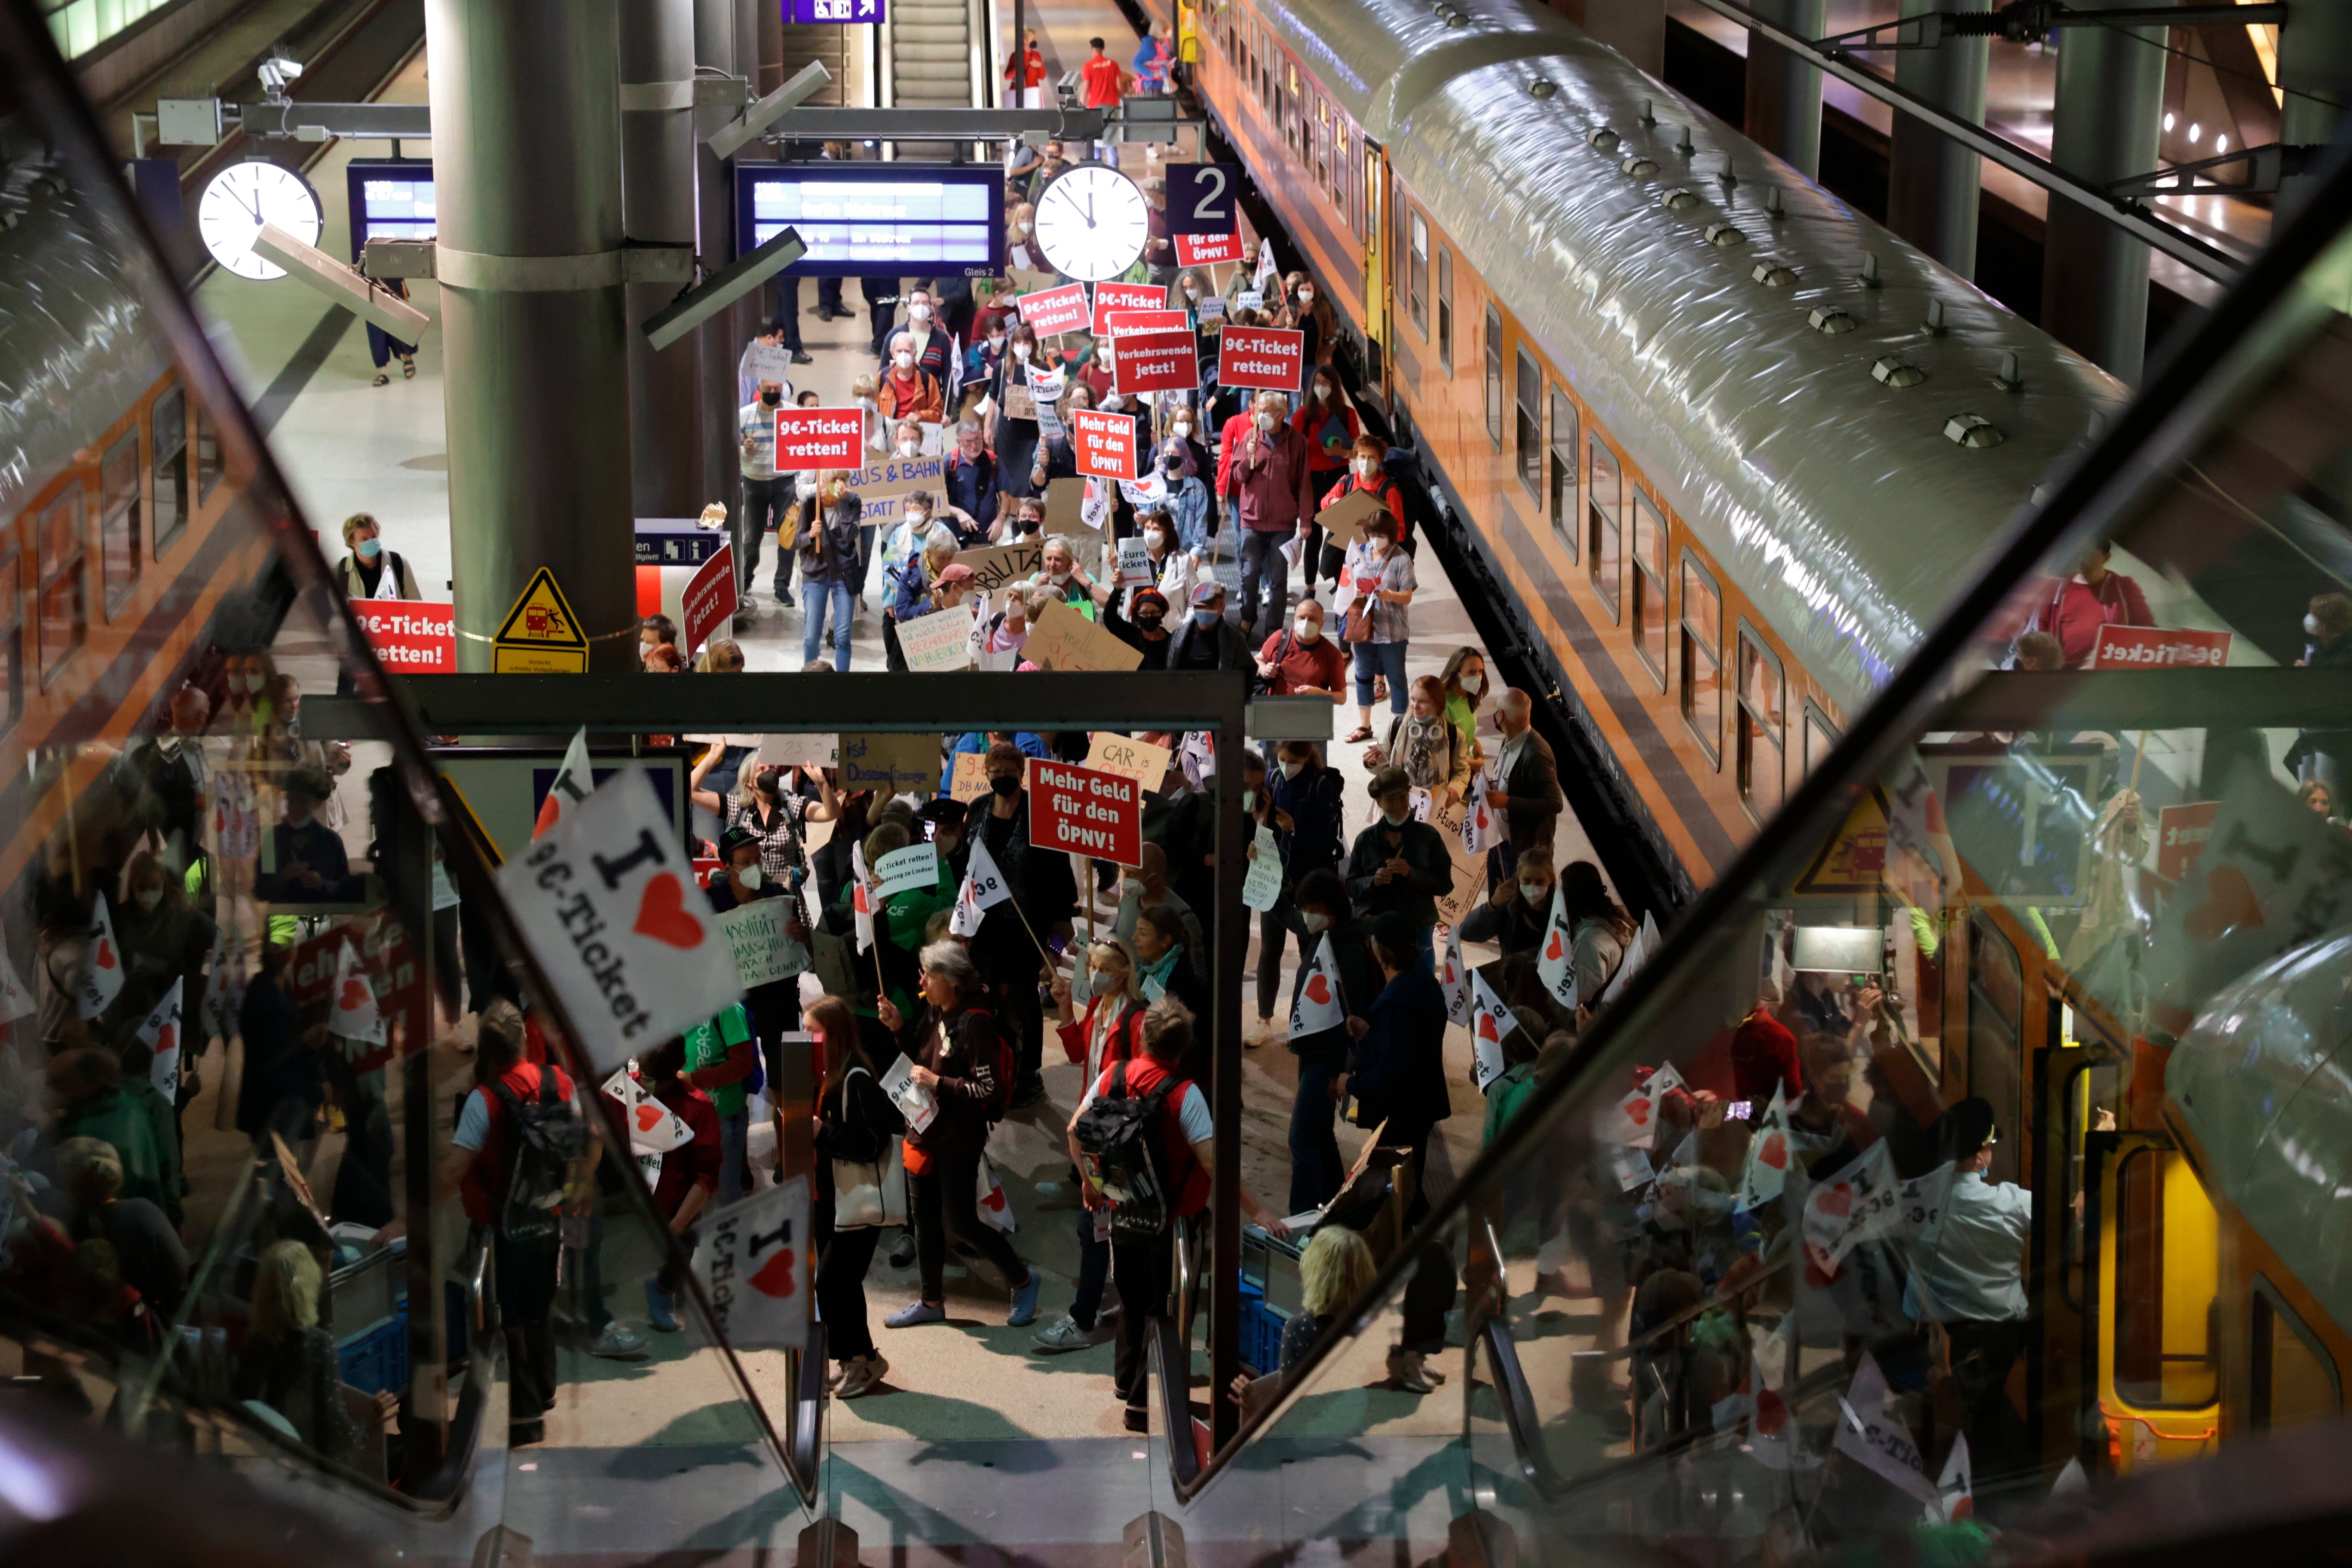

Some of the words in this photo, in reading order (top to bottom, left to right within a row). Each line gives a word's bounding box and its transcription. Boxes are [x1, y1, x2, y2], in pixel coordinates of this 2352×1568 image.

[1194, 167, 1225, 218] 2
[802, 202, 839, 217] Berlin
[843, 202, 907, 218] Südkreuz
[1188, 234, 1205, 245] für
[1208, 234, 1228, 243] den
[1193, 246, 1228, 260] ÖPNV!
[965, 268, 986, 276] Gleis
[987, 268, 994, 276] 2
[1023, 293, 1083, 315] 9€-Ticket
[1098, 292, 1162, 309] 9€-Ticket
[1034, 309, 1078, 328] retten!
[1118, 345, 1192, 360] Verkehrswende
[1225, 337, 1298, 356] 9€-Ticket
[1135, 361, 1176, 379] jetzt!
[1233, 361, 1287, 376] retten!
[780, 419, 859, 436] 9€-Ticket
[1080, 416, 1105, 431] Mehr
[1107, 419, 1130, 435] Geld
[789, 441, 847, 456] retten!
[1087, 434, 1104, 449] für
[1106, 437, 1124, 452] den
[1091, 451, 1122, 472] ÖPNV!
[850, 466, 882, 486] BUS
[887, 465, 898, 482] &
[902, 459, 940, 480] BAHN
[860, 500, 896, 520] STATT
[684, 565, 730, 620] Verkehrswende
[692, 591, 719, 634] jetzt!
[375, 645, 442, 665] etten!
[846, 738, 867, 758] ist
[1103, 745, 1134, 768] CAR
[1141, 757, 1149, 768] is
[958, 781, 971, 791] DB
[1040, 767, 1086, 792] Mehr
[1090, 778, 1130, 802] Geld
[1053, 794, 1081, 815] für
[1086, 801, 1119, 824] den
[1057, 818, 1115, 851] ÖPNV!
[591, 828, 665, 891] I
[909, 853, 933, 863] retten!
[882, 873, 903, 884] nderzug
[912, 866, 934, 875] Lindner
